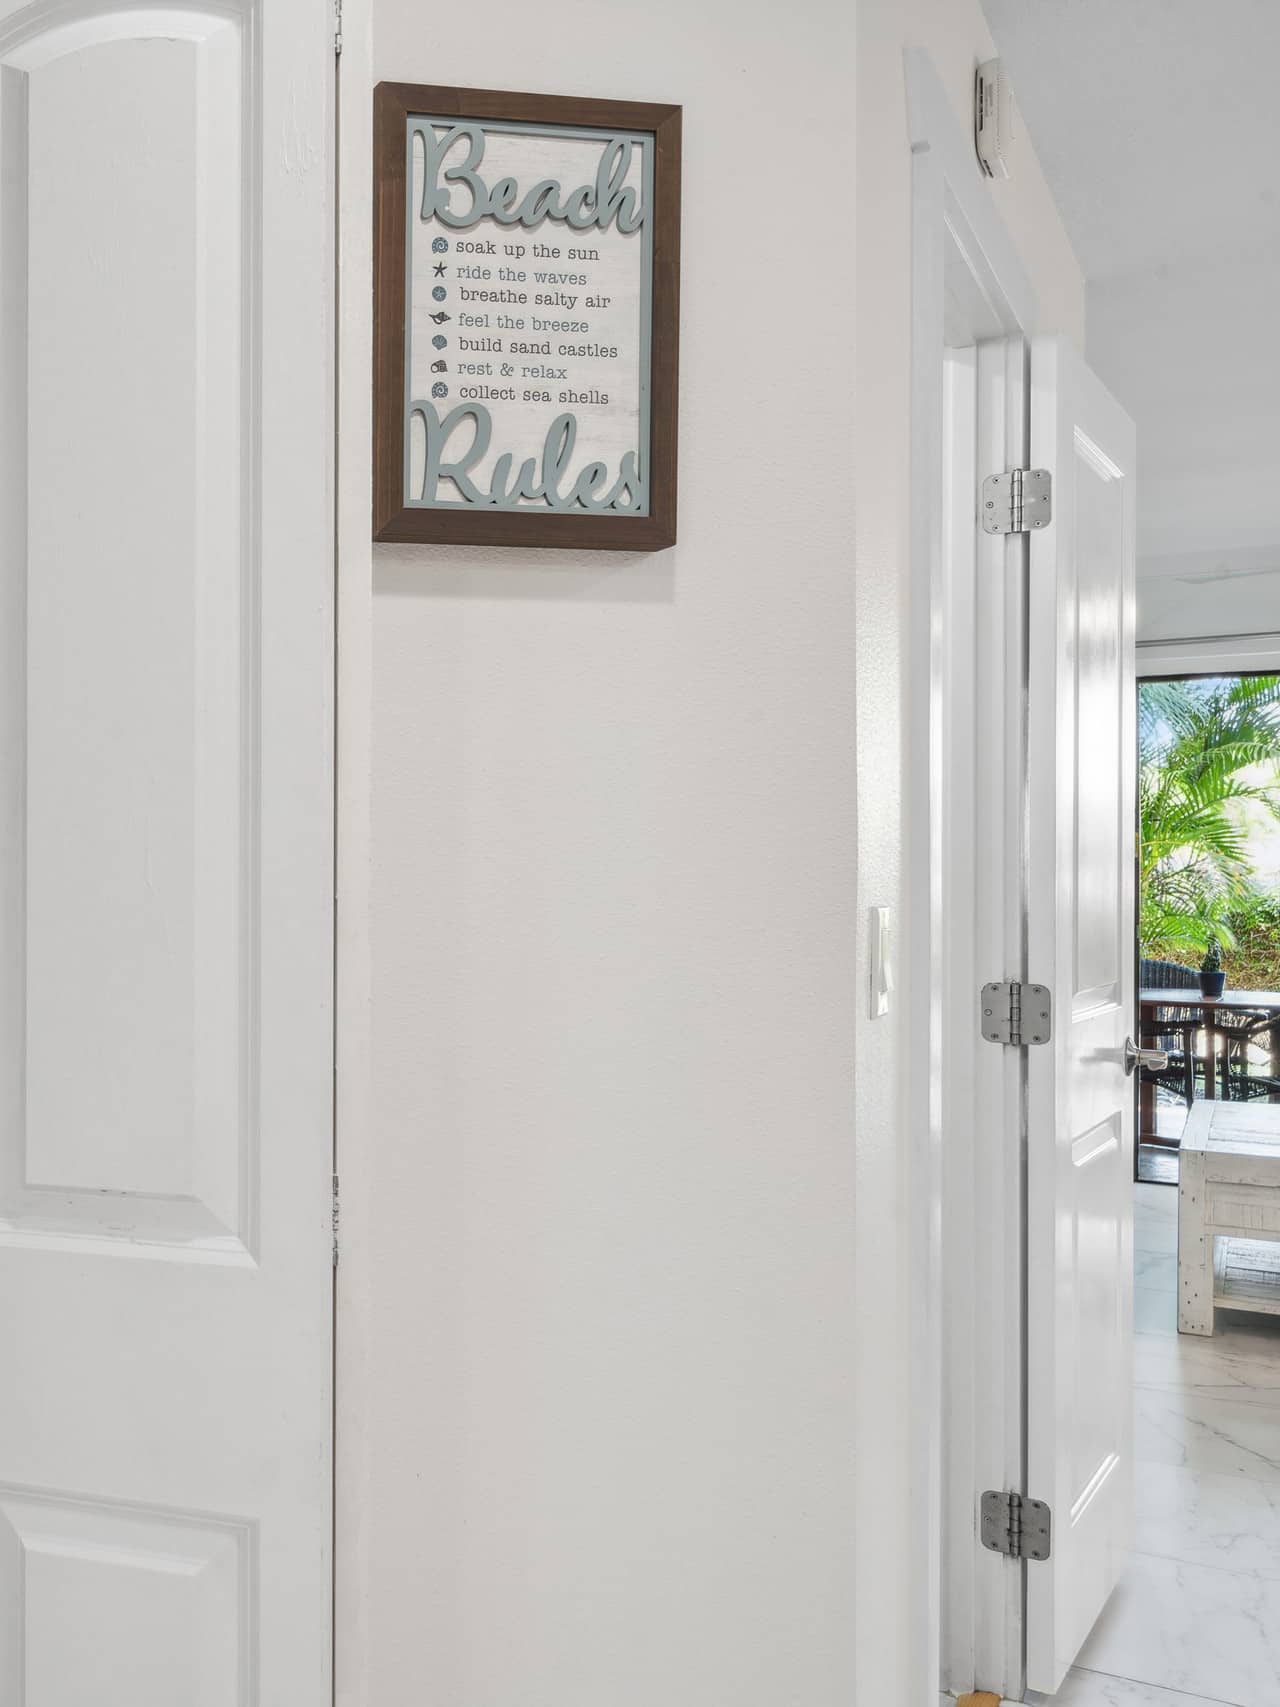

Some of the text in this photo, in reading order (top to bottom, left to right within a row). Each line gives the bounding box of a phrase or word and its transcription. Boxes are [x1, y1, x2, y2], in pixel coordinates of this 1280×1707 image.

[413, 125, 645, 234] Beach
[456, 241, 600, 260] soak up the sun
[456, 265, 587, 285] ride the waves
[459, 287, 611, 309] breathe salty air
[458, 313, 589, 333] feel the breeze
[458, 337, 618, 358] build sand castles
[457, 362, 568, 379] rest & relax
[459, 386, 609, 404] collect sea shells
[410, 400, 641, 509] Rules
